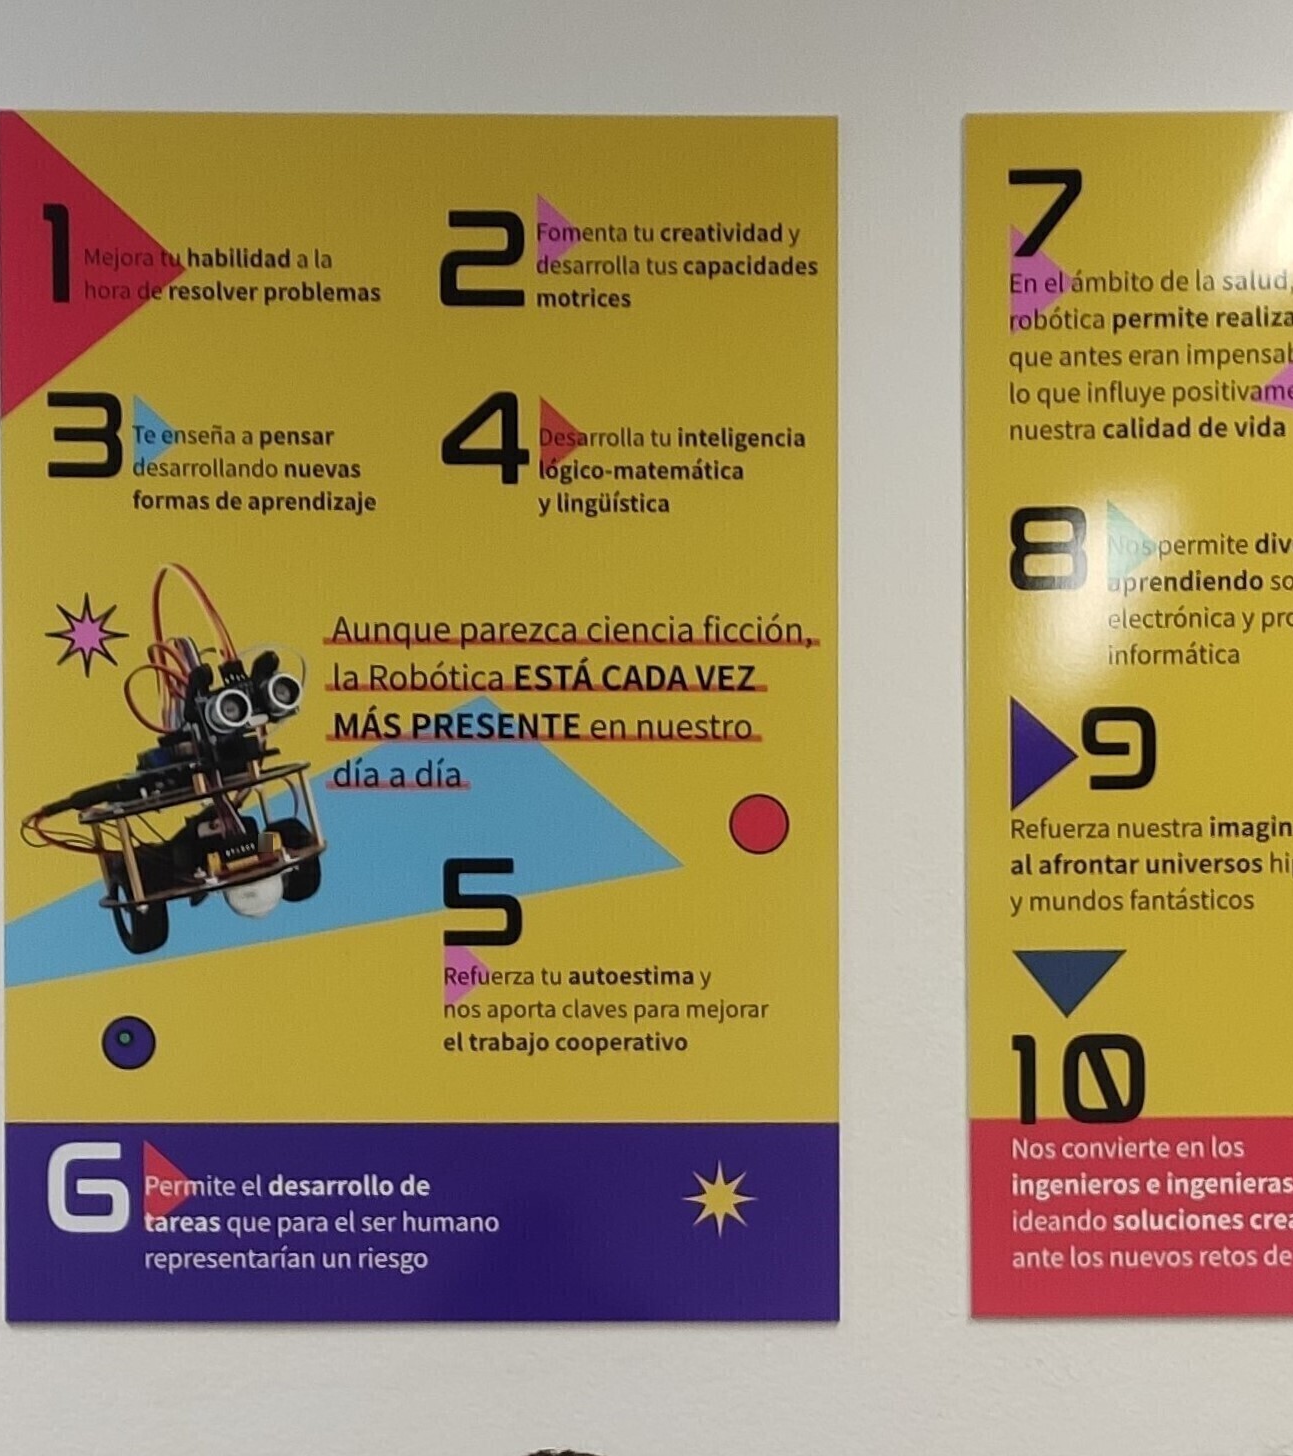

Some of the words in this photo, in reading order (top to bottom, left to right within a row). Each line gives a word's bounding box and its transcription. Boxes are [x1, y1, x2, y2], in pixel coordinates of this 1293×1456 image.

[1008, 167, 1084, 258] 7
[537, 223, 627, 242] Fomenta
[660, 222, 782, 242] creatividad
[42, 202, 72, 304] 1
[86, 249, 153, 270] Mejora
[187, 247, 291, 269] habilidad
[438, 208, 526, 309] 2
[537, 255, 639, 275] desarrolla
[647, 258, 677, 275] tus
[683, 255, 818, 280] capacidades
[86, 282, 130, 298] hora
[169, 281, 258, 302] resolver
[264, 281, 382, 307] problemas
[1010, 273, 1037, 294] En
[1071, 269, 1154, 293] ámbito
[1160, 269, 1188, 292] de
[1223, 270, 1293, 294] salud,
[535, 287, 632, 310] motrices
[1010, 306, 1104, 332] robótica
[1113, 306, 1208, 335] permite
[1009, 351, 1052, 373] que
[1059, 347, 1122, 367] antes
[1129, 349, 1179, 366] eran
[1010, 382, 1030, 404] lo
[1037, 387, 1080, 409] que
[1088, 380, 1166, 408] influye
[46, 390, 123, 479] 3
[132, 425, 156, 444] Te
[162, 425, 235, 445] enseña
[260, 431, 334, 450] pensar
[440, 389, 530, 486] 4
[540, 427, 644, 447] Desarrolla
[678, 427, 805, 452] inteligencia
[1010, 421, 1095, 440] nuestra
[1103, 416, 1190, 439] calidad
[1198, 416, 1227, 438] de
[1234, 415, 1285, 437] vida
[133, 457, 278, 478] desarrollando
[285, 463, 360, 478] nuevas
[538, 456, 745, 484] lógico-matemática
[133, 489, 209, 510] formas
[216, 491, 242, 510] de
[248, 491, 376, 516] aprendizaje
[557, 490, 669, 518] lingüística
[1009, 505, 1088, 592] 8
[1159, 533, 1248, 560] permite
[1110, 569, 1263, 597] aprendiendo
[1109, 605, 1235, 629] electrónica
[331, 617, 450, 649] Aunque
[460, 621, 576, 647] parezca
[587, 617, 693, 643] ciencia
[702, 613, 815, 650] ficción,
[1107, 641, 1241, 668] informática
[332, 663, 359, 691] la
[370, 662, 503, 692] Robótica
[514, 659, 597, 692] ESTÁ
[602, 665, 688, 691] CADA
[696, 665, 756, 691] VEZ
[335, 705, 401, 740] MÁS
[413, 713, 581, 740] PRESENTE
[591, 720, 626, 740] en
[634, 715, 751, 740] nuestro
[1080, 706, 1157, 791] 9
[334, 758, 379, 788] día
[416, 758, 461, 788] día
[1010, 817, 1110, 840] Refuerza
[1118, 819, 1202, 838] nuestra
[1011, 854, 1032, 875] al
[1039, 853, 1139, 875] afrontar
[1146, 852, 1262, 874] universos
[443, 856, 523, 946] 5
[1030, 889, 1123, 911] mundos
[1130, 887, 1254, 911] fantásticos
[445, 965, 534, 985] Refuerza
[569, 965, 694, 985] autoestima
[444, 1004, 481, 1018] nos
[487, 1001, 556, 1023] aporta
[562, 998, 627, 1018] claves
[634, 1004, 679, 1024] para
[687, 999, 769, 1024] mejorar
[469, 1032, 549, 1056] trabajo
[556, 1032, 688, 1056] cooperativo
[1012, 1033, 1146, 1125] 10
[1013, 1138, 1056, 1159] Nos
[1062, 1136, 1170, 1159] convierte
[1176, 1141, 1204, 1158] en
[1212, 1135, 1244, 1158] los
[146, 1175, 235, 1196] Permite
[269, 1174, 394, 1196] desarrollo
[400, 1174, 430, 1196] de
[1012, 1172, 1140, 1200] ingenieros
[1167, 1171, 1293, 1200] ingenieras
[144, 1212, 221, 1232] tareas
[227, 1217, 271, 1238] que
[278, 1216, 328, 1238] para
[362, 1216, 396, 1232] ser
[403, 1210, 499, 1232] humano
[1013, 1208, 1107, 1232] ideando
[1113, 1208, 1244, 1231] soluciones
[145, 1245, 315, 1274] representarían
[323, 1253, 351, 1269] un
[359, 1247, 428, 1274] riesgo
[1013, 1248, 1064, 1268] ante
[1071, 1245, 1103, 1268] los
[1110, 1250, 1193, 1267] nuevos
[1200, 1246, 1257, 1267] retos
[1263, 1244, 1292, 1266] de
